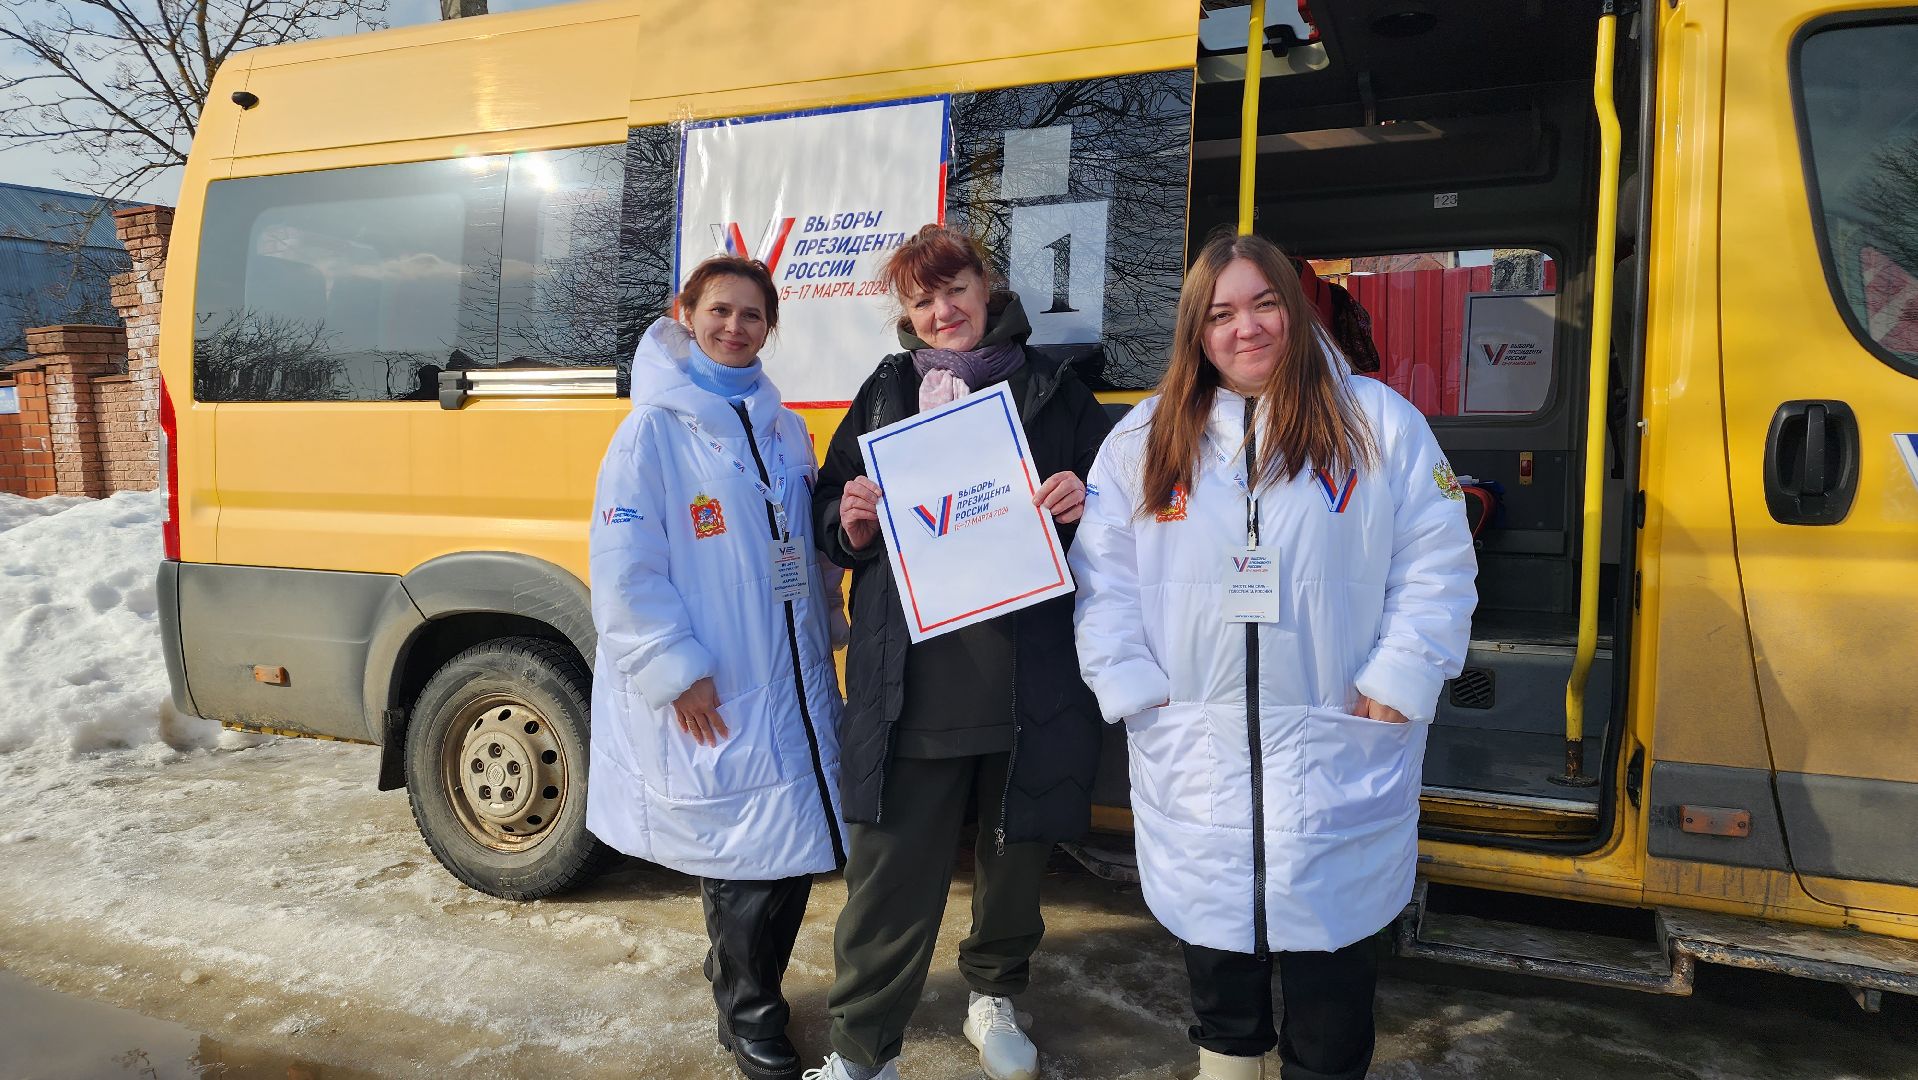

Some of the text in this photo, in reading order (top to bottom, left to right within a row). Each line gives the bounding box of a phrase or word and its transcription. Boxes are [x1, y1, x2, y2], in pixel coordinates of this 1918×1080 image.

[803, 211, 883, 233] ВЫБОРЫ
[793, 232, 906, 256] ПРЕЗИДЕНТА
[784, 259, 856, 280] РОССИИ
[1041, 233, 1079, 314] 1
[812, 282, 855, 298] МАРТА
[856, 280, 889, 297] 2024
[956, 484, 1011, 510] ПРЕЗИДЕНТА
[958, 479, 996, 498] ВЫБОРЫ
[955, 503, 990, 521] РОССИИ
[971, 513, 993, 526] МАРТА
